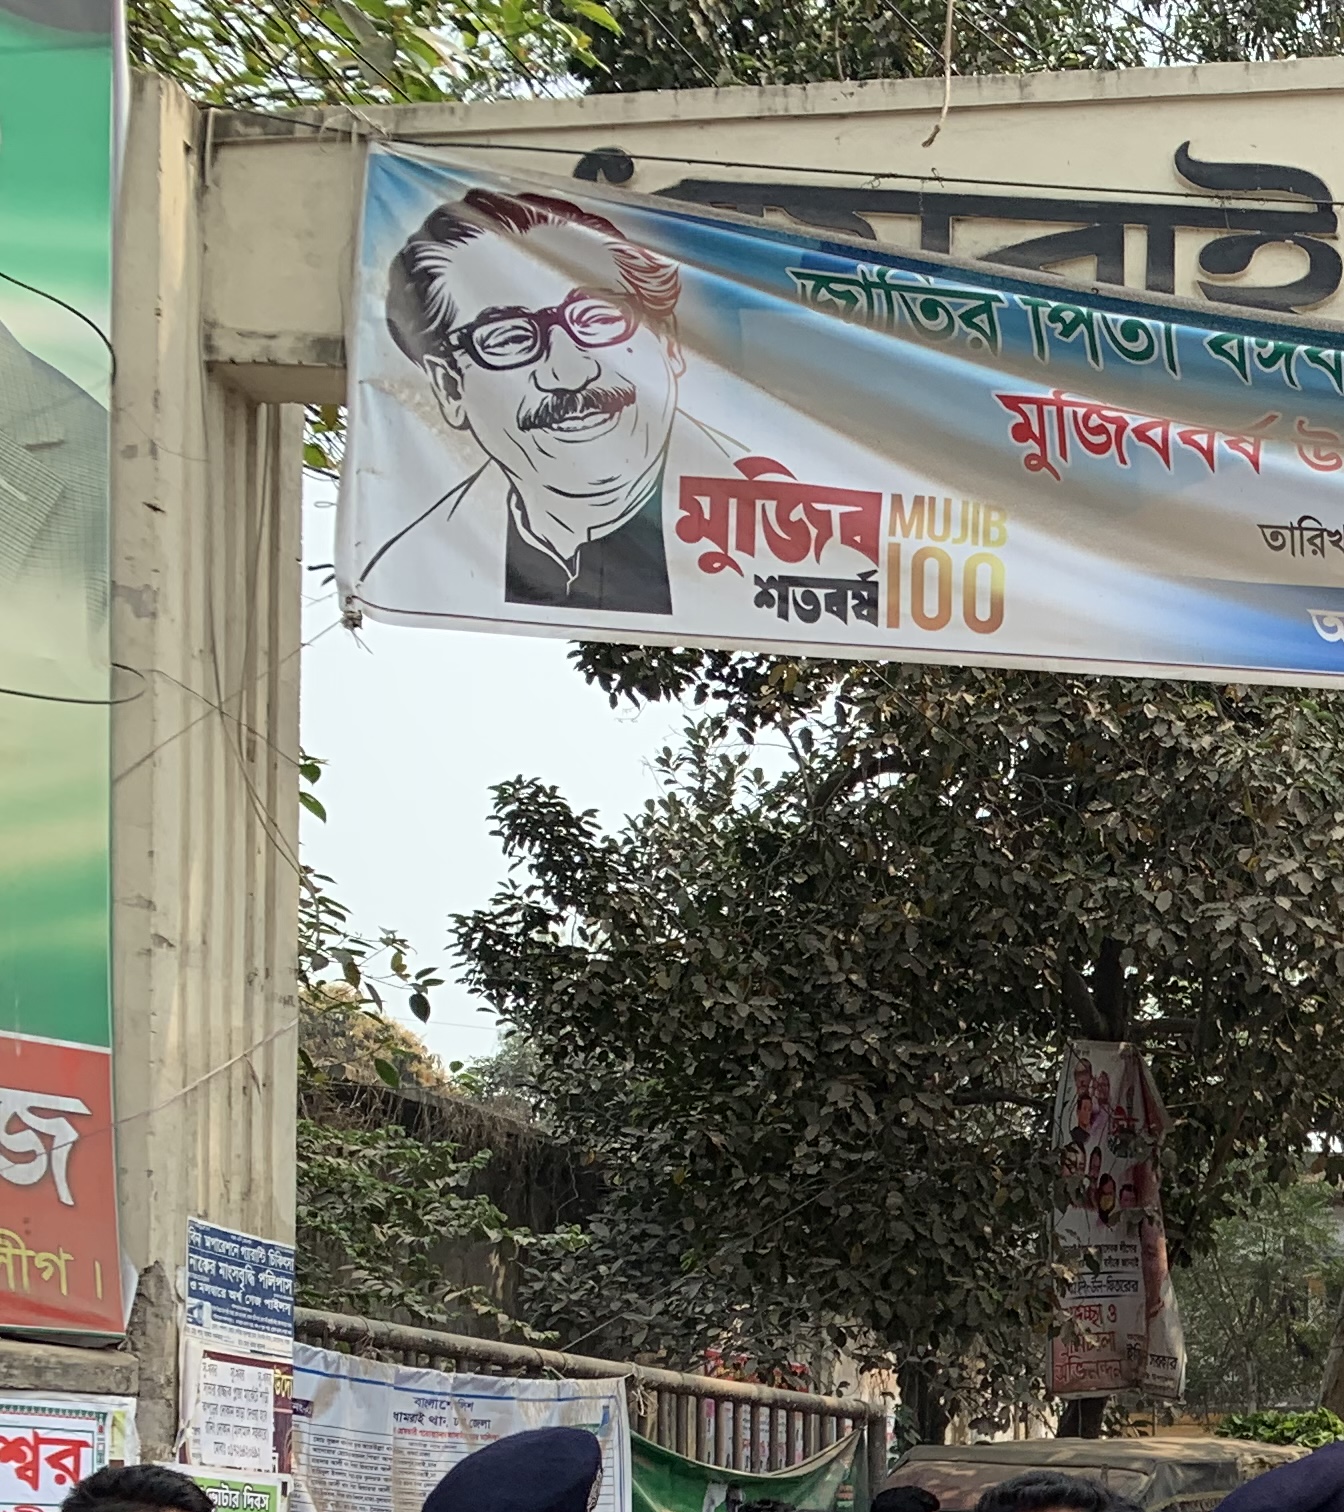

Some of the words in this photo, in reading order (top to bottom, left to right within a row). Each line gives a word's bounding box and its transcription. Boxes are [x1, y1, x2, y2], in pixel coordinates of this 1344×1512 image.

[788, 267, 1001, 357] জাতির
[1015, 295, 1179, 380] পিতা
[994, 388, 1281, 483] মুজিববর্ষ
[675, 457, 882, 580] মুজিব
[887, 492, 1008, 548] MUJIB
[752, 570, 880, 628] শতবর্ষ
[887, 543, 1008, 636] 100
[243, 1482, 271, 1512] দিবস
